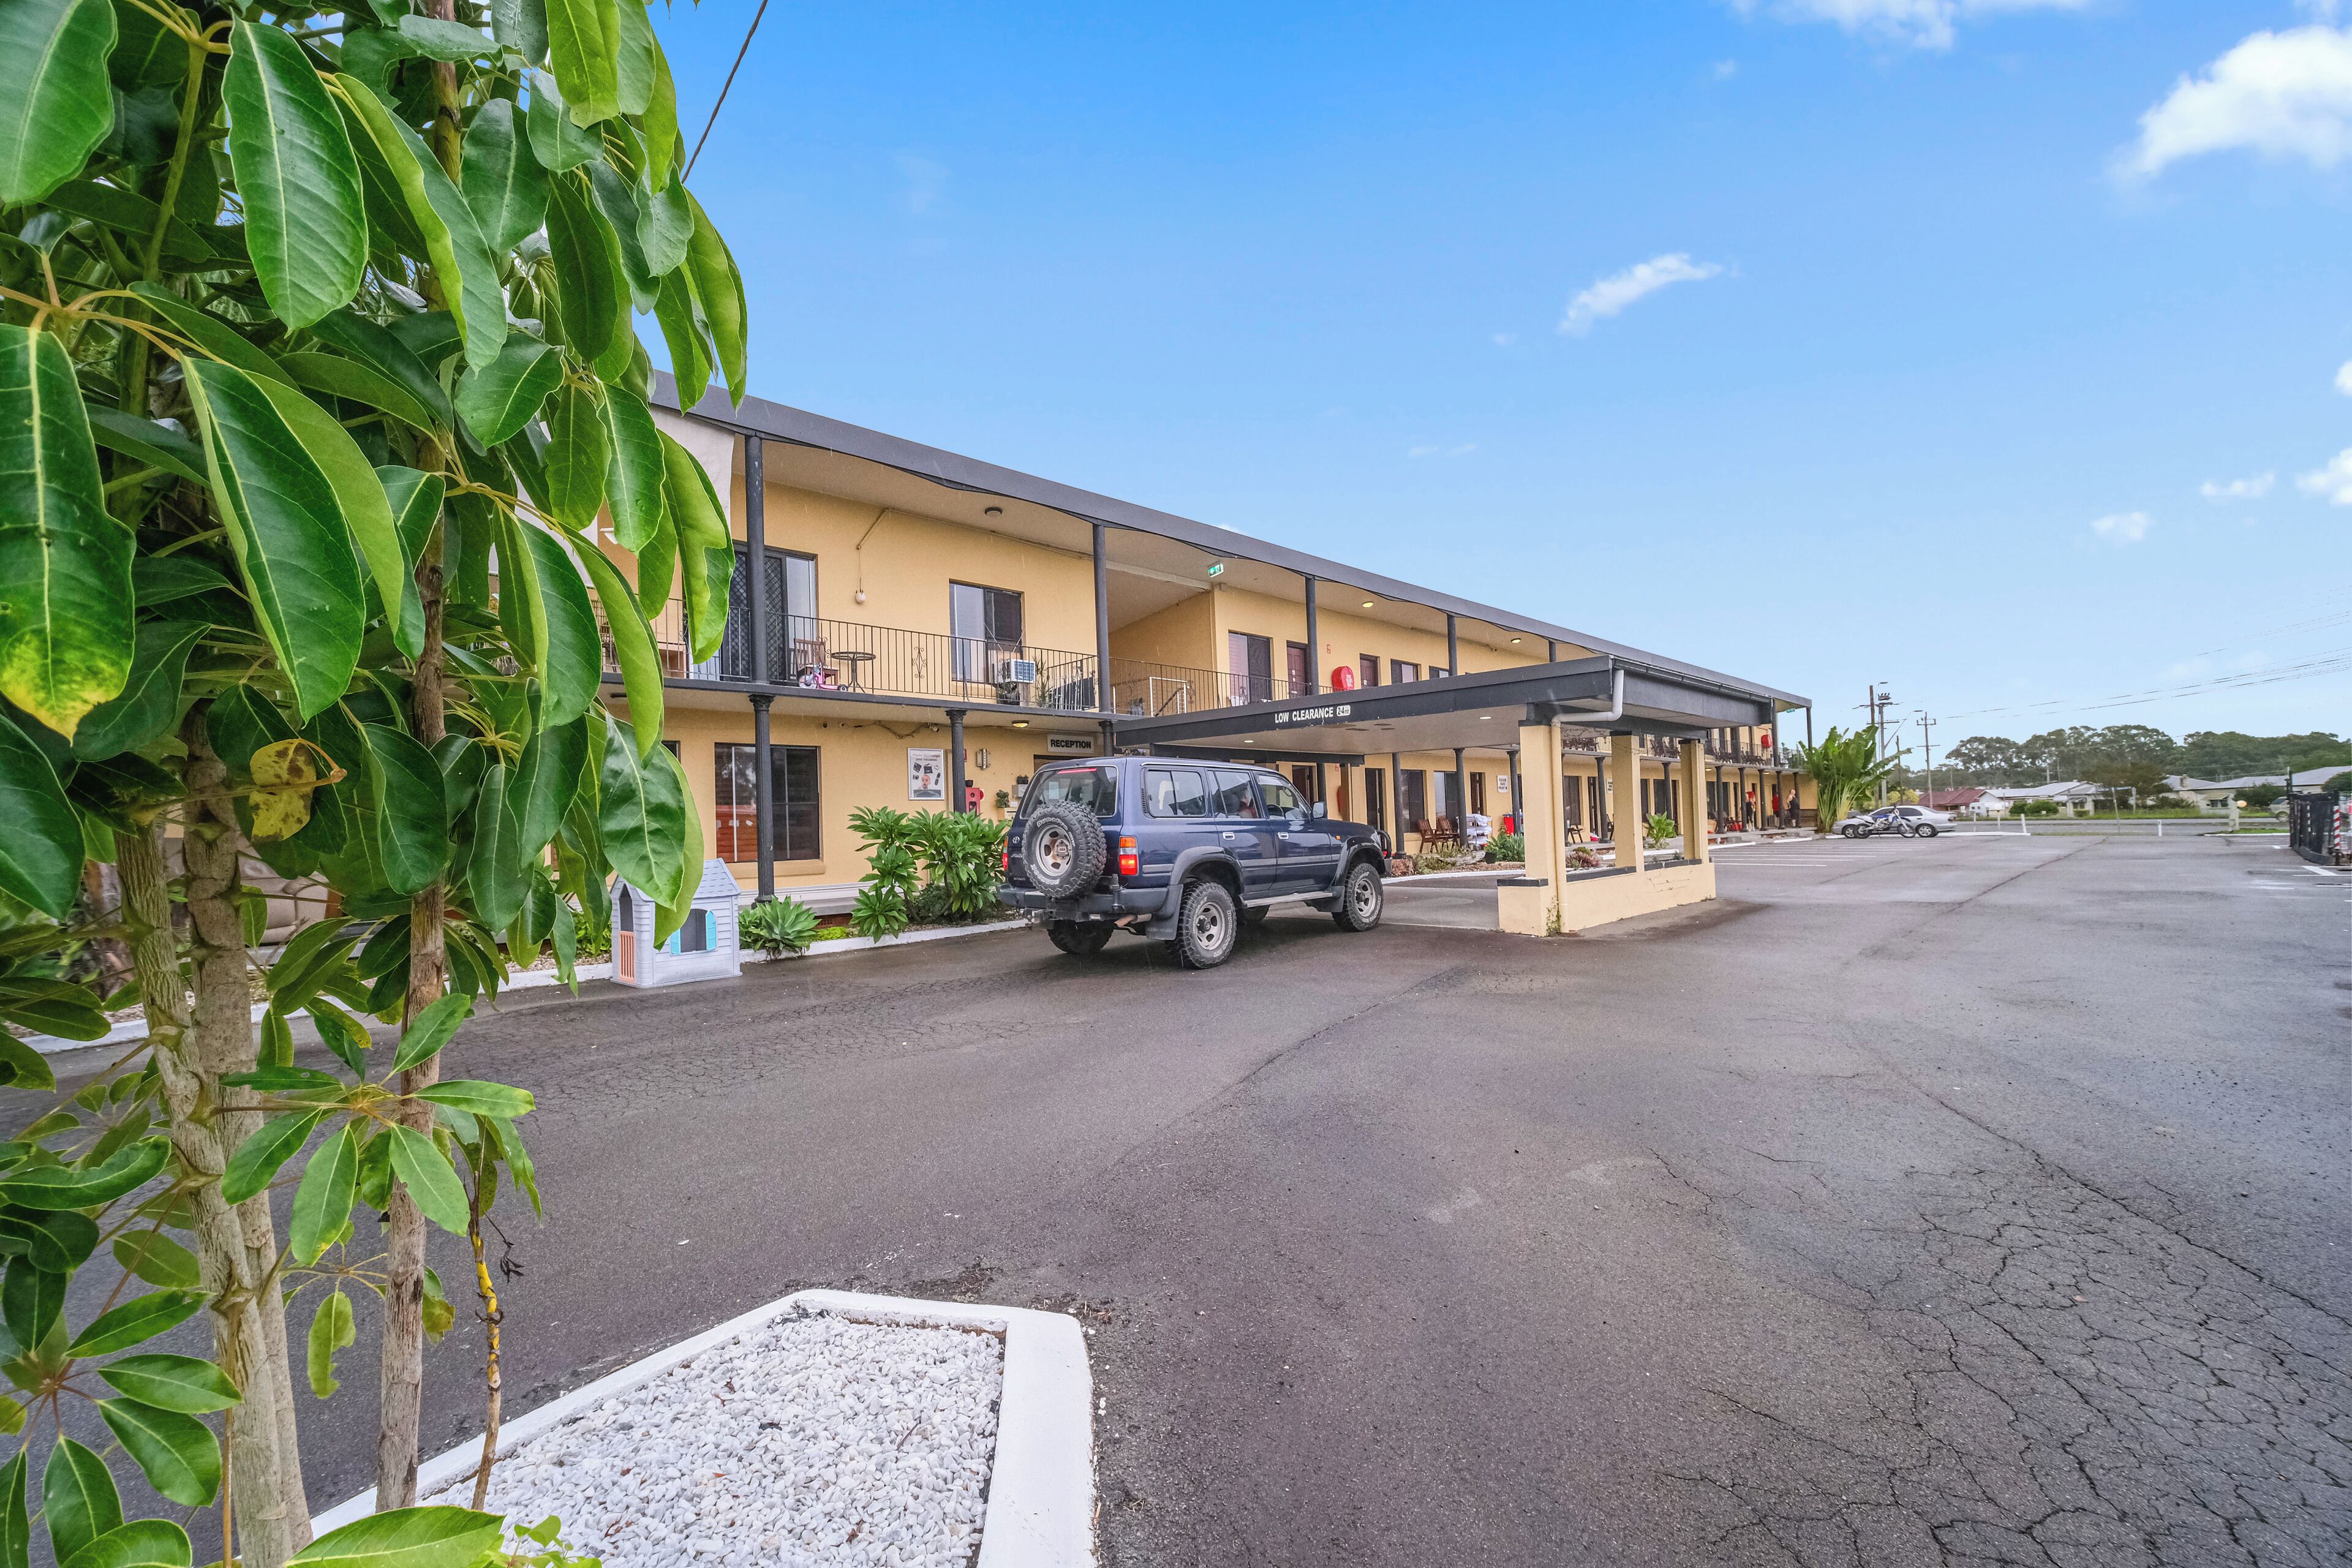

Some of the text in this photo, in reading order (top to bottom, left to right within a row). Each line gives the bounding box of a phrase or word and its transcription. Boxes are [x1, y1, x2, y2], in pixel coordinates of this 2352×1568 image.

[1275, 712, 1289, 723] LOW
[1292, 707, 1333, 721] CLEARANCE
[1050, 739, 1091, 748] RECEPTION
